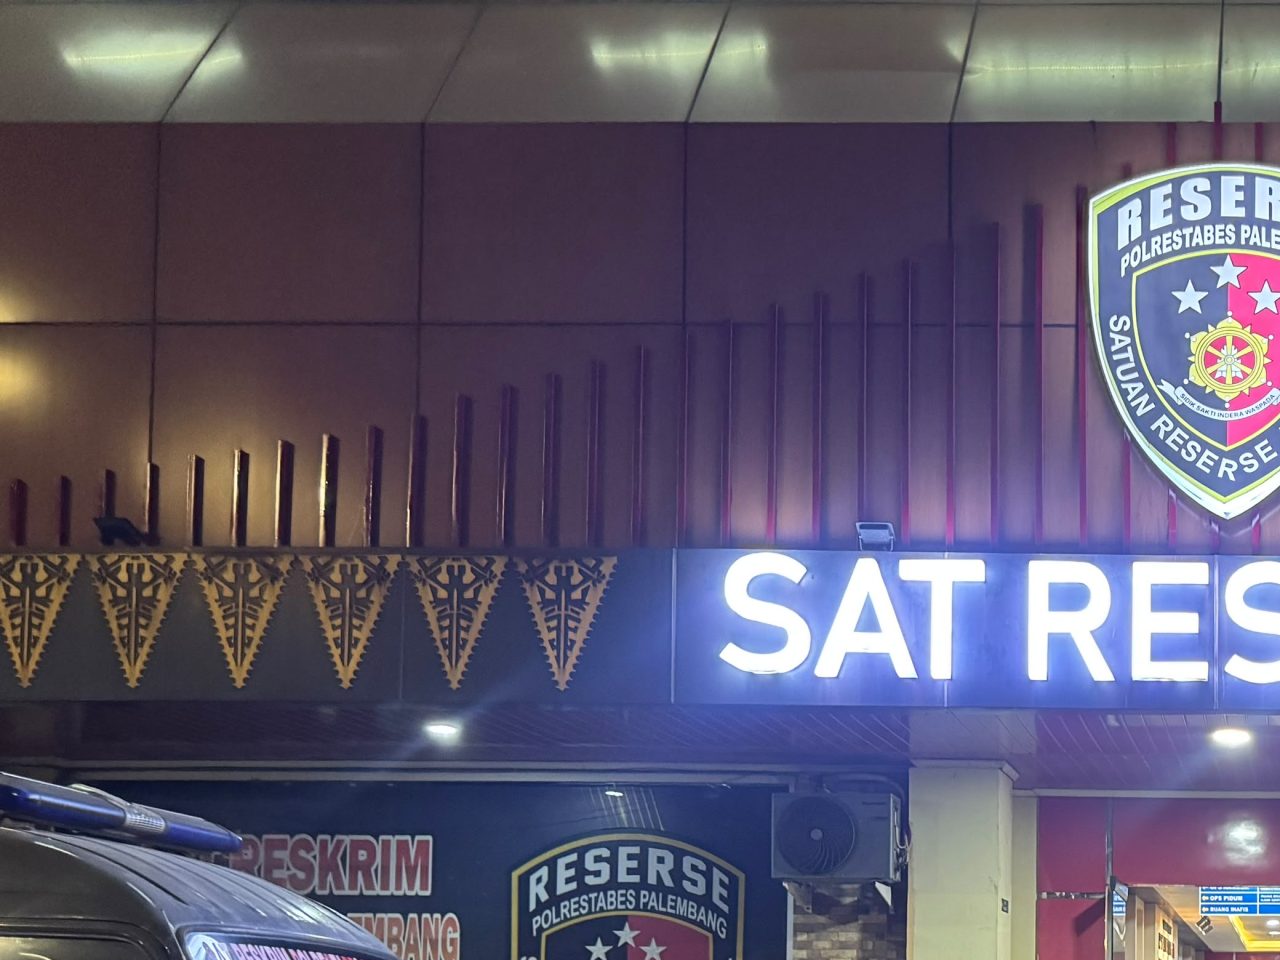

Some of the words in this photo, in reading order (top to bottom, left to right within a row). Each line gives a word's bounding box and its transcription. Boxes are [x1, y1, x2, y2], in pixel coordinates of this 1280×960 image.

[1120, 224, 1236, 278] POLRESTABES
[1109, 314, 1155, 418] SATUAN
[1150, 415, 1278, 482] RESERSE
[1180, 393, 1195, 407] SIDIK
[1196, 405, 1216, 417] SAKTI
[1217, 410, 1244, 419] INDERA
[1245, 393, 1275, 415] WASPADA
[719, 552, 986, 680] SAT
[229, 833, 433, 896] RESKRIM
[529, 846, 730, 914] RESERSE
[532, 889, 636, 937] POLRESTABES
[640, 891, 727, 940] PALEMBANG
